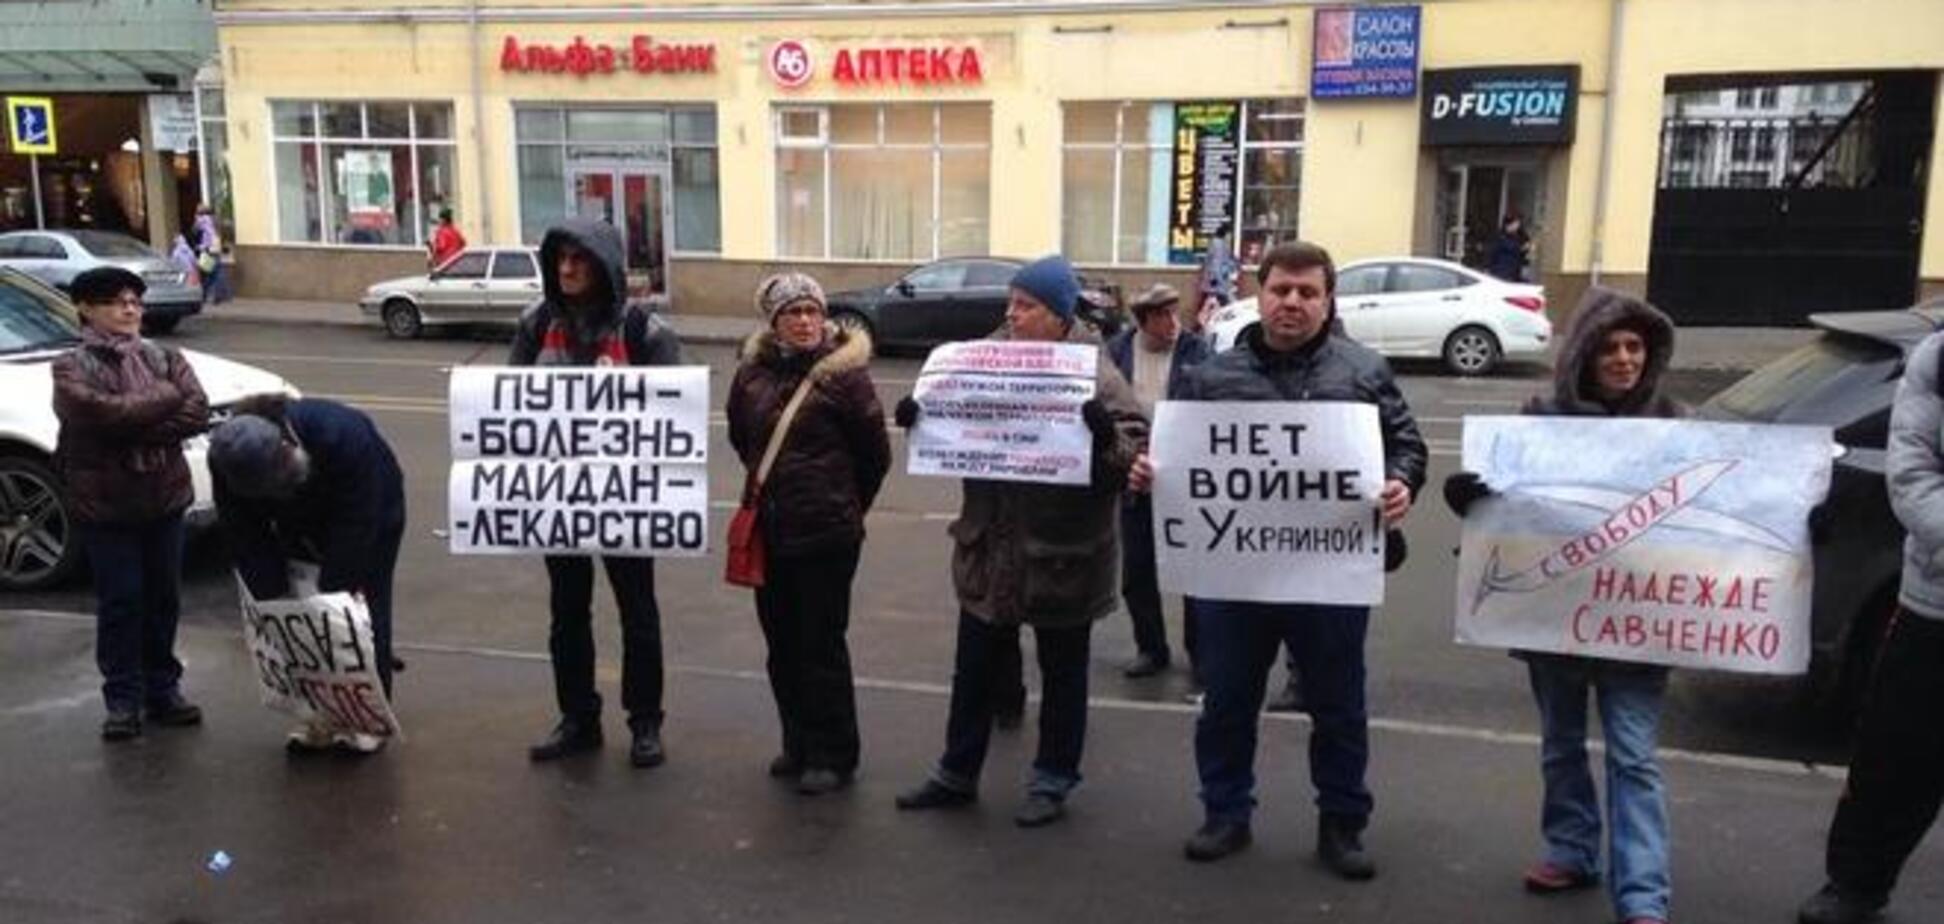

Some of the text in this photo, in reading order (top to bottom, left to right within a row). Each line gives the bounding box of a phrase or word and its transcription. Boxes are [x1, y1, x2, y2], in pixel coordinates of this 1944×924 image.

[1357, 17, 1413, 36] САЛОН
[833, 48, 983, 83] АПТЕКА
[1173, 127, 1196, 249] ЦВЕТЫ
[494, 374, 646, 411] ПУТИН
[1209, 423, 1307, 456] НЕТ
[471, 457, 660, 505] МАЙДАН
[1189, 459, 1362, 501] ВОЙНЕ
[1541, 475, 1686, 579] СВОБОДУ
[1592, 567, 1775, 613] НАДЕЖДЕ
